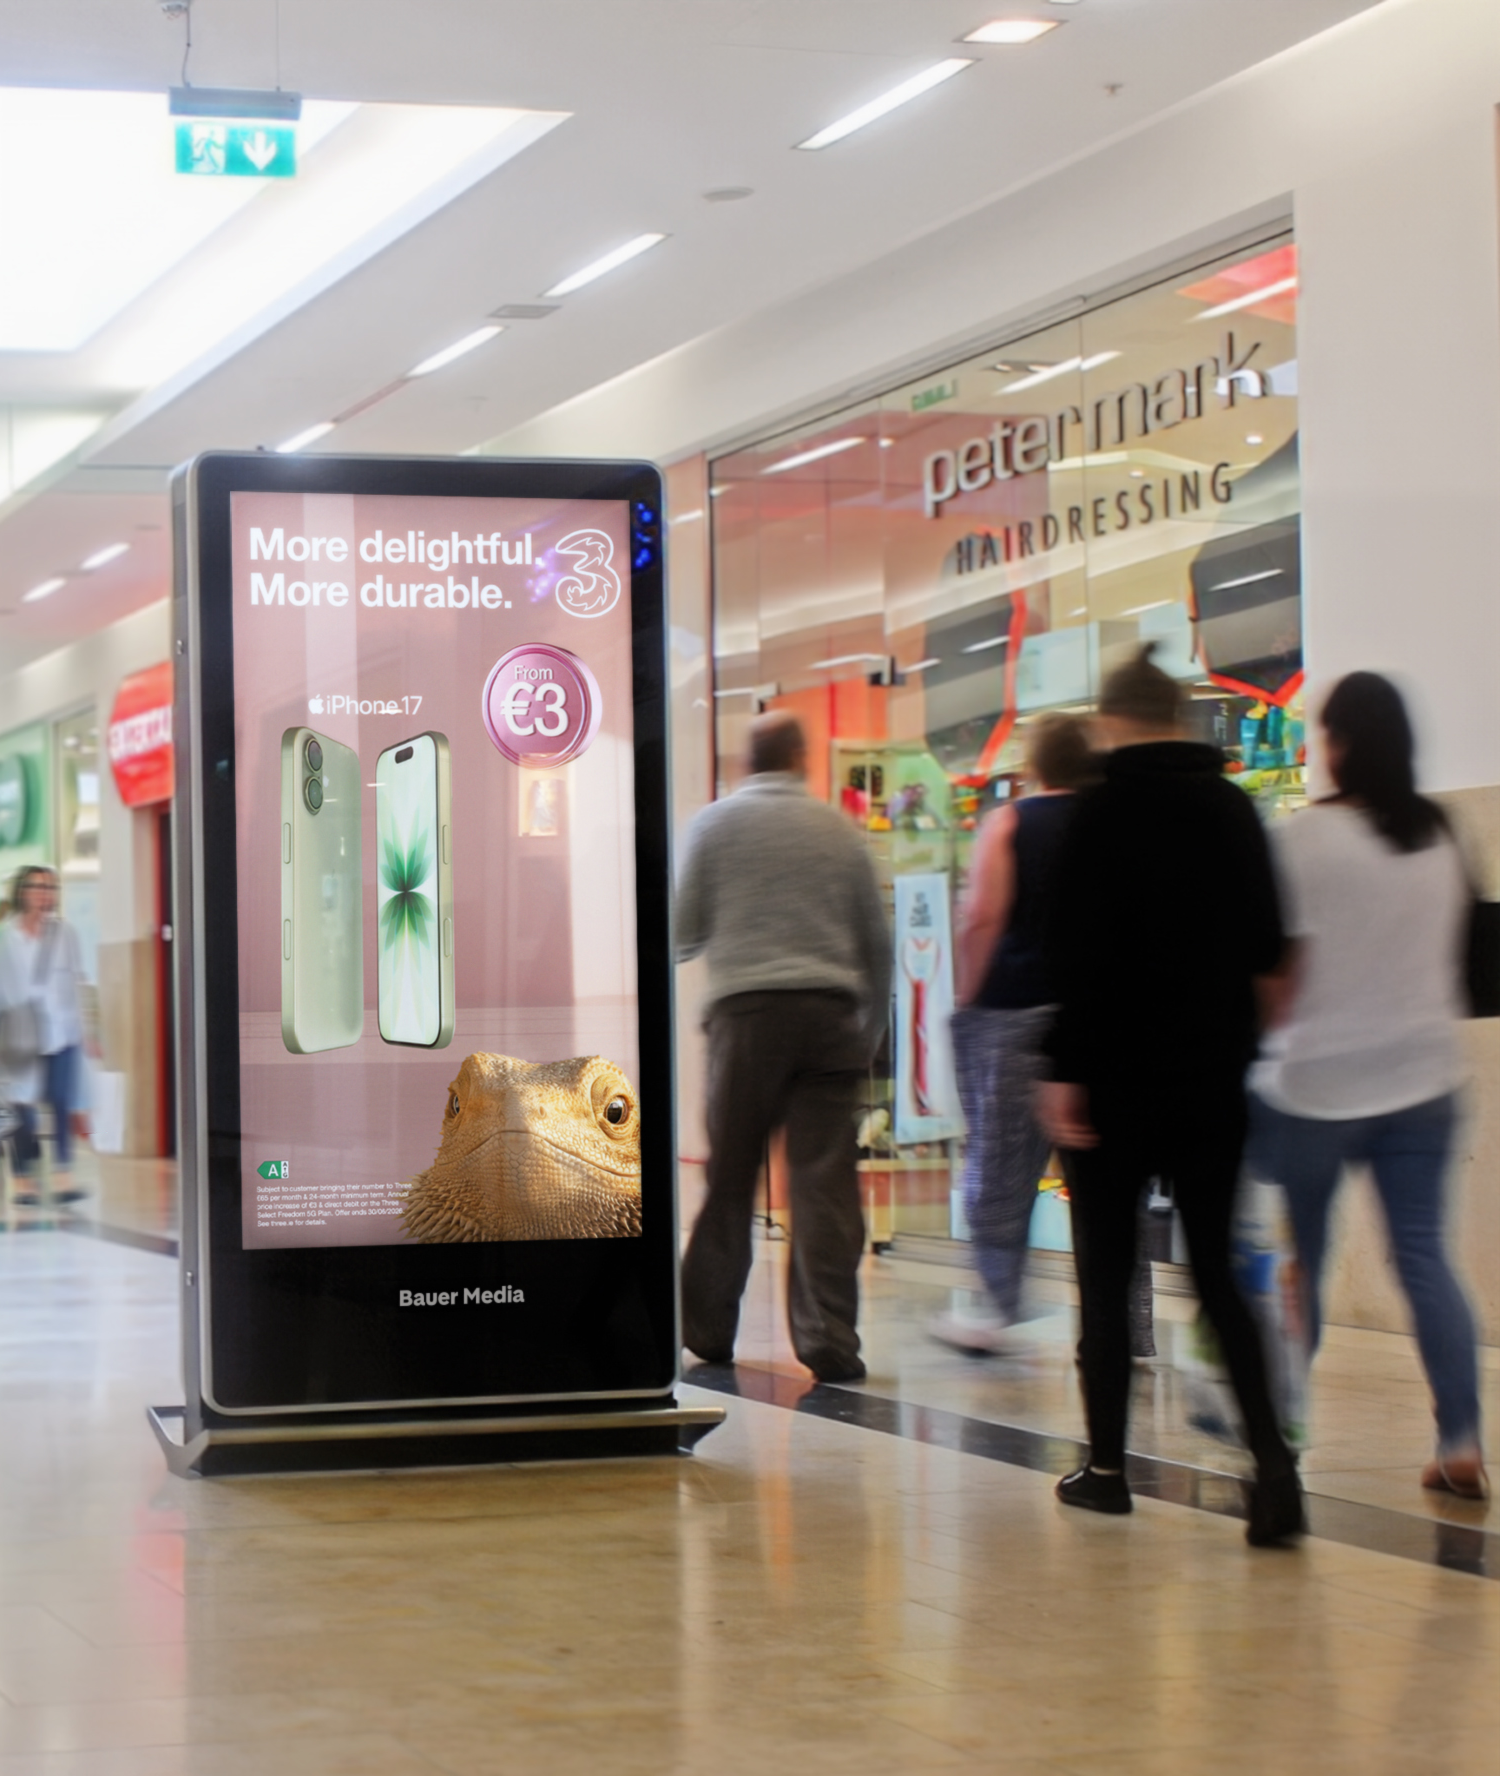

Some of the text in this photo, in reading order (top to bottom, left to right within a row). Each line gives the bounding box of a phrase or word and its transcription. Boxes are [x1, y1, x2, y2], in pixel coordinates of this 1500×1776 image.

[955, 462, 1232, 576] HAIRDRESSING
[250, 527, 543, 572] More delightful.
[250, 572, 513, 609] More durable.
[514, 665, 553, 680] From
[326, 695, 423, 715] iPhone 17
[500, 681, 569, 737] €3
[268, 1164, 279, 1177] A
[257, 1186, 280, 1194] Subject
[320, 1184, 345, 1192] bringing
[304, 1218, 328, 1226] details.
[318, 1209, 333, 1217] Plan.
[399, 1284, 525, 1307] Bauer Media
